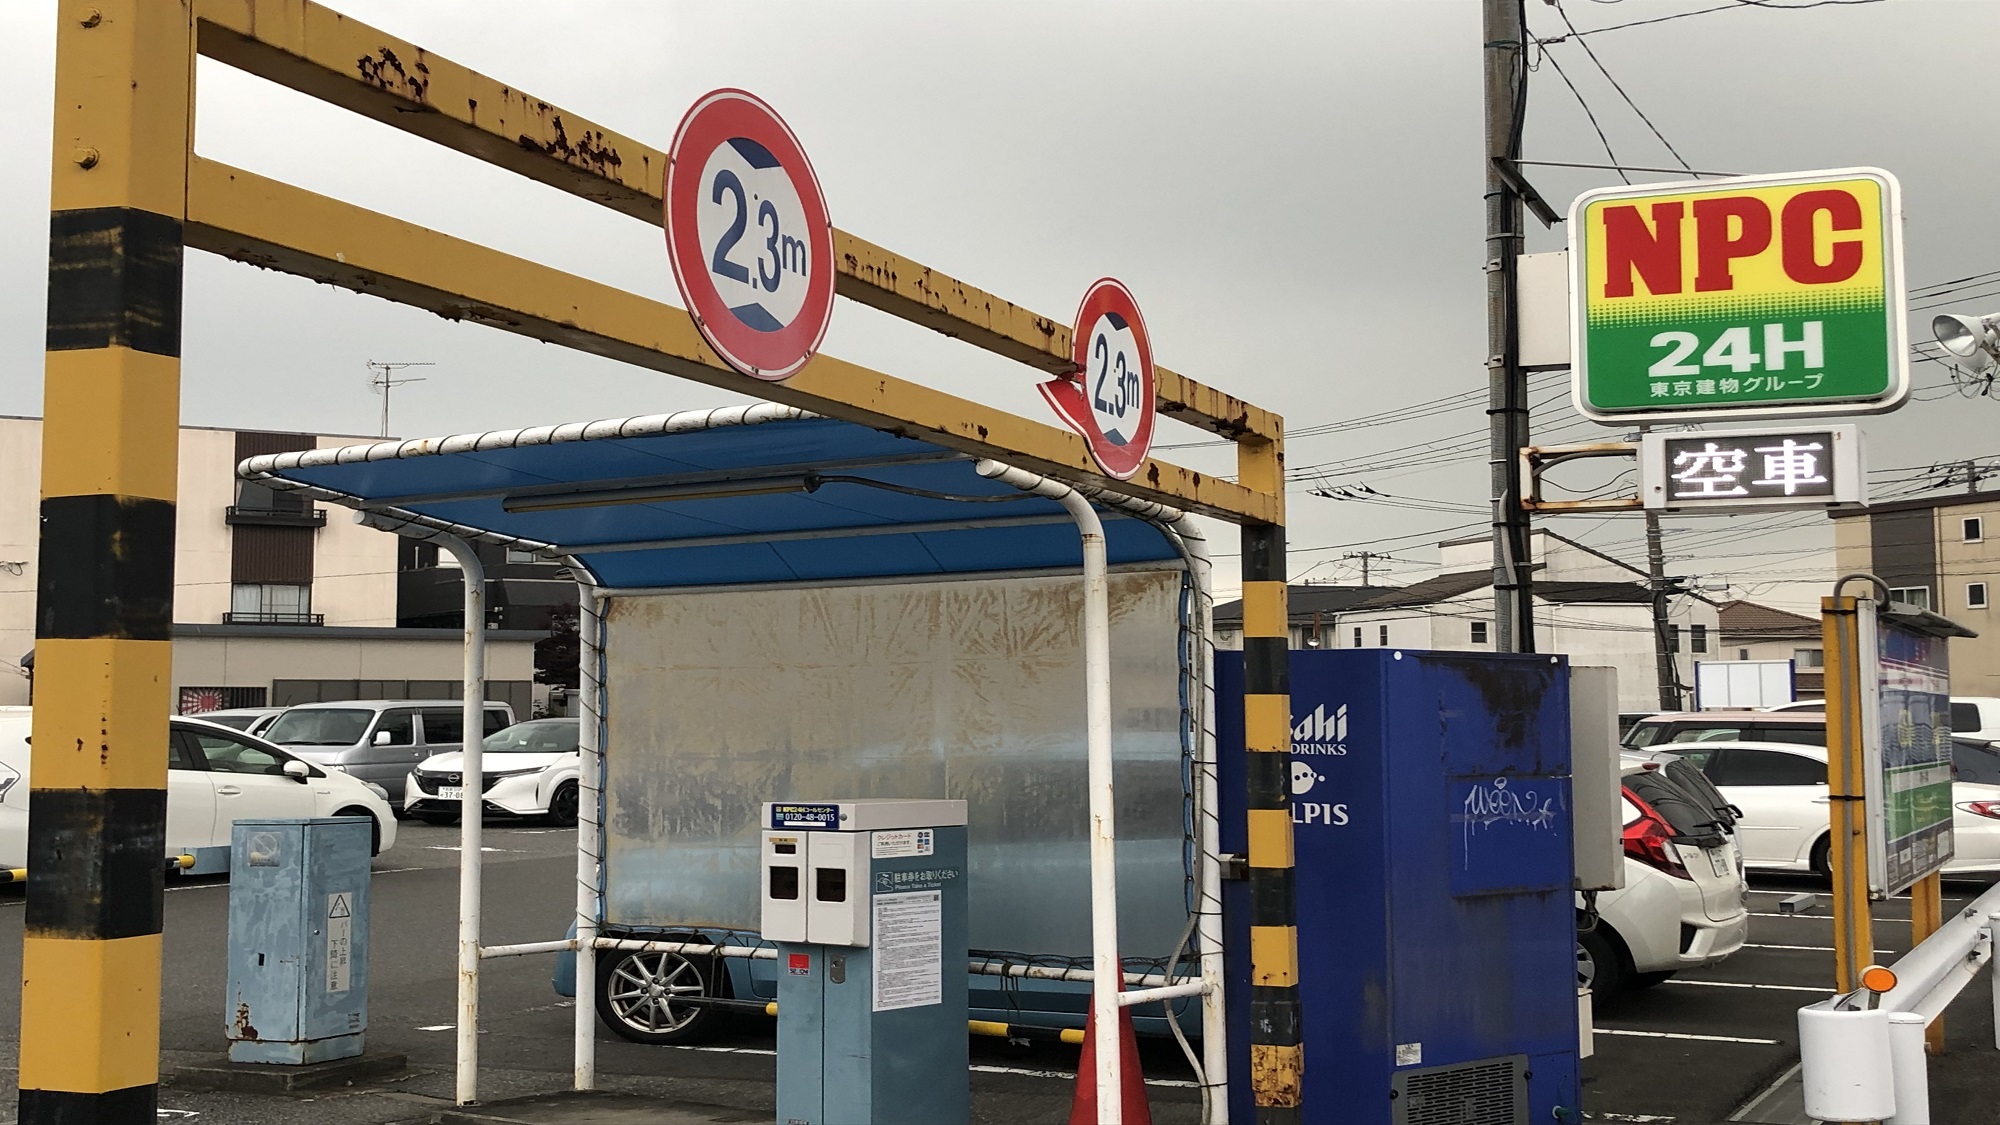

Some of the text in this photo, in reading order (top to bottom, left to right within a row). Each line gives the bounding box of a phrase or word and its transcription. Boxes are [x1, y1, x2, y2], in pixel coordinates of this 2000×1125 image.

[712, 169, 807, 293] 2.3m
[1603, 189, 1863, 298] NPC
[1094, 332, 1139, 419] 2.3m
[1648, 320, 1825, 378] 24H
[1649, 373, 1825, 398] 東京建物グループ
[1670, 438, 1828, 496] 空車
[1289, 703, 1348, 742] ahi
[785, 813, 835, 822] 0120-48-0015
